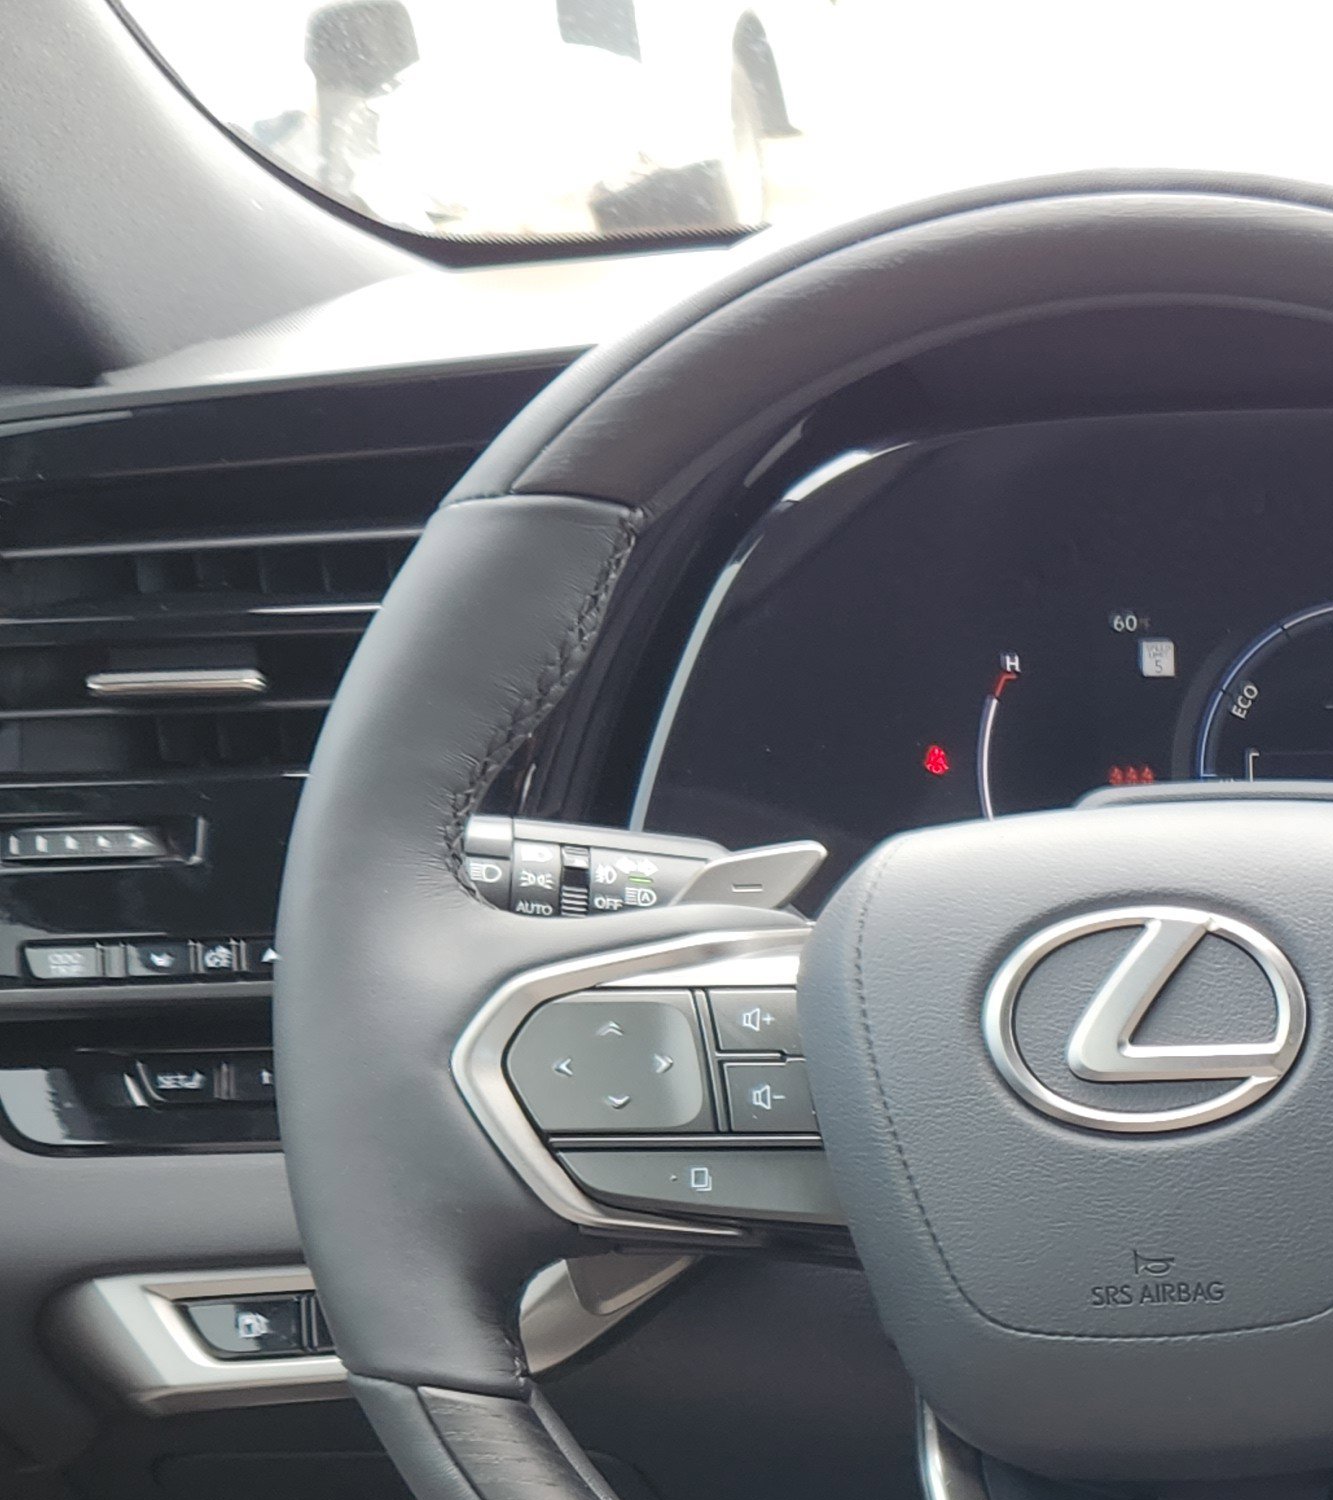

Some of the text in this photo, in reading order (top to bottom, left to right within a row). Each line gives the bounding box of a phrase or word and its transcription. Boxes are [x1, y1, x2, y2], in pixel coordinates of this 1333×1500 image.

[1113, 615, 1138, 632] 60
[1005, 655, 1021, 672] H
[1231, 684, 1259, 719] ECO
[515, 900, 553, 916] AUTO
[594, 898, 623, 911] OFF
[1091, 1281, 1225, 1307] SRS AIRBAG
